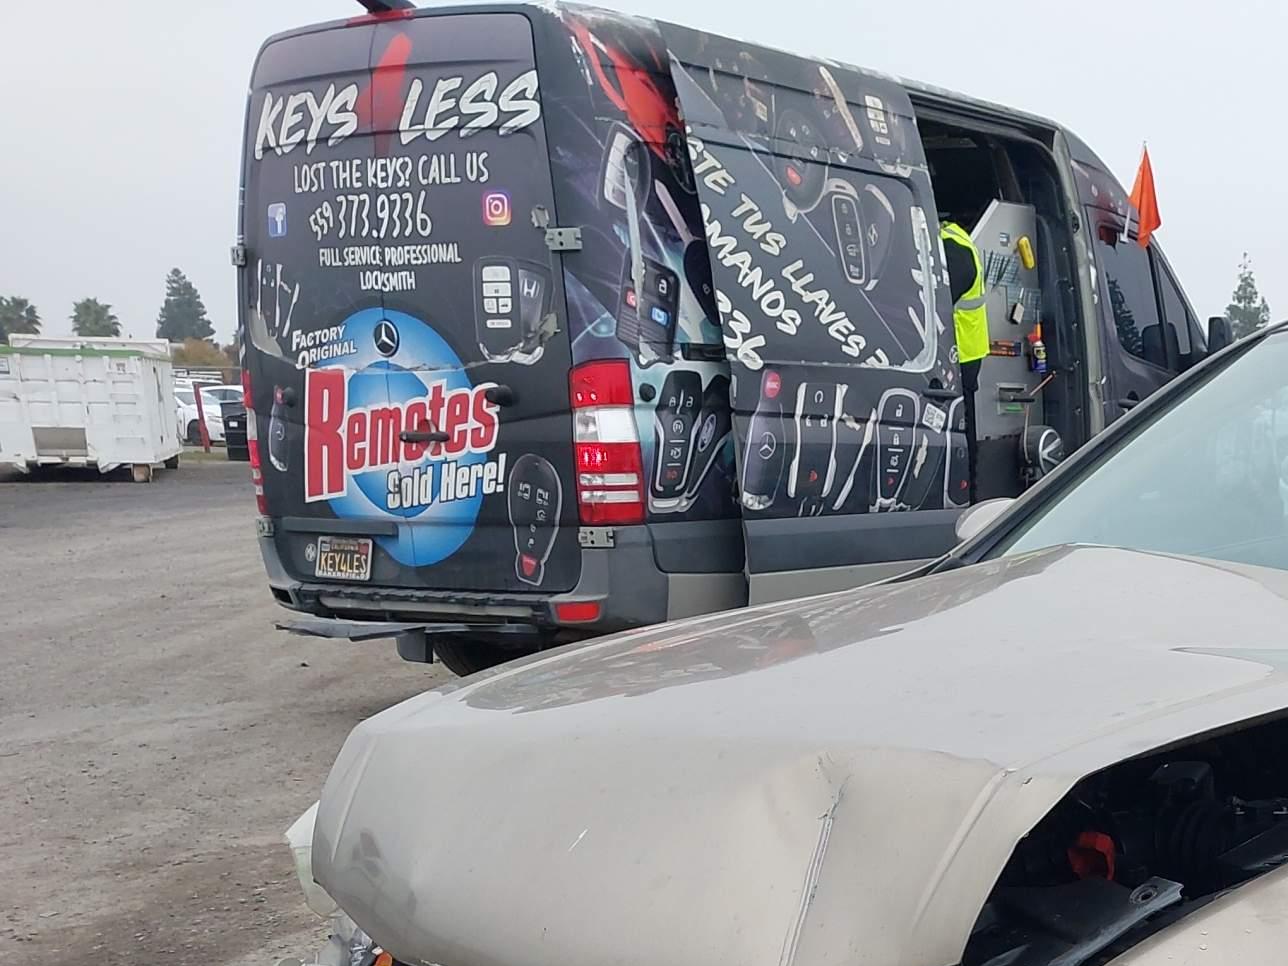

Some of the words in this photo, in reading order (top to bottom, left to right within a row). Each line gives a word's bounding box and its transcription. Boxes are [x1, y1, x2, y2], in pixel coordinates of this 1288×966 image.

[254, 83, 358, 160] KEYS
[398, 69, 541, 145] LESS
[294, 160, 326, 193] LOST
[330, 158, 362, 188] THE
[367, 156, 413, 188] KEYS?
[417, 154, 461, 185] CALL
[465, 151, 489, 183] US
[309, 201, 334, 241] 559
[336, 189, 432, 239] 373.9336
[686, 135, 736, 195] STE
[731, 193, 787, 257] TUS
[319, 247, 342, 267] FULL
[384, 243, 462, 266] PROFESSIONAL
[360, 270, 416, 292] LOCKSMITH
[291, 324, 346, 352] FACTORY
[296, 338, 357, 370] ORIGINAL
[304, 366, 500, 503] Remotes
[386, 465, 434, 509] Sold
[439, 452, 506, 502] Here!
[320, 552, 367, 573] KEY4LES
